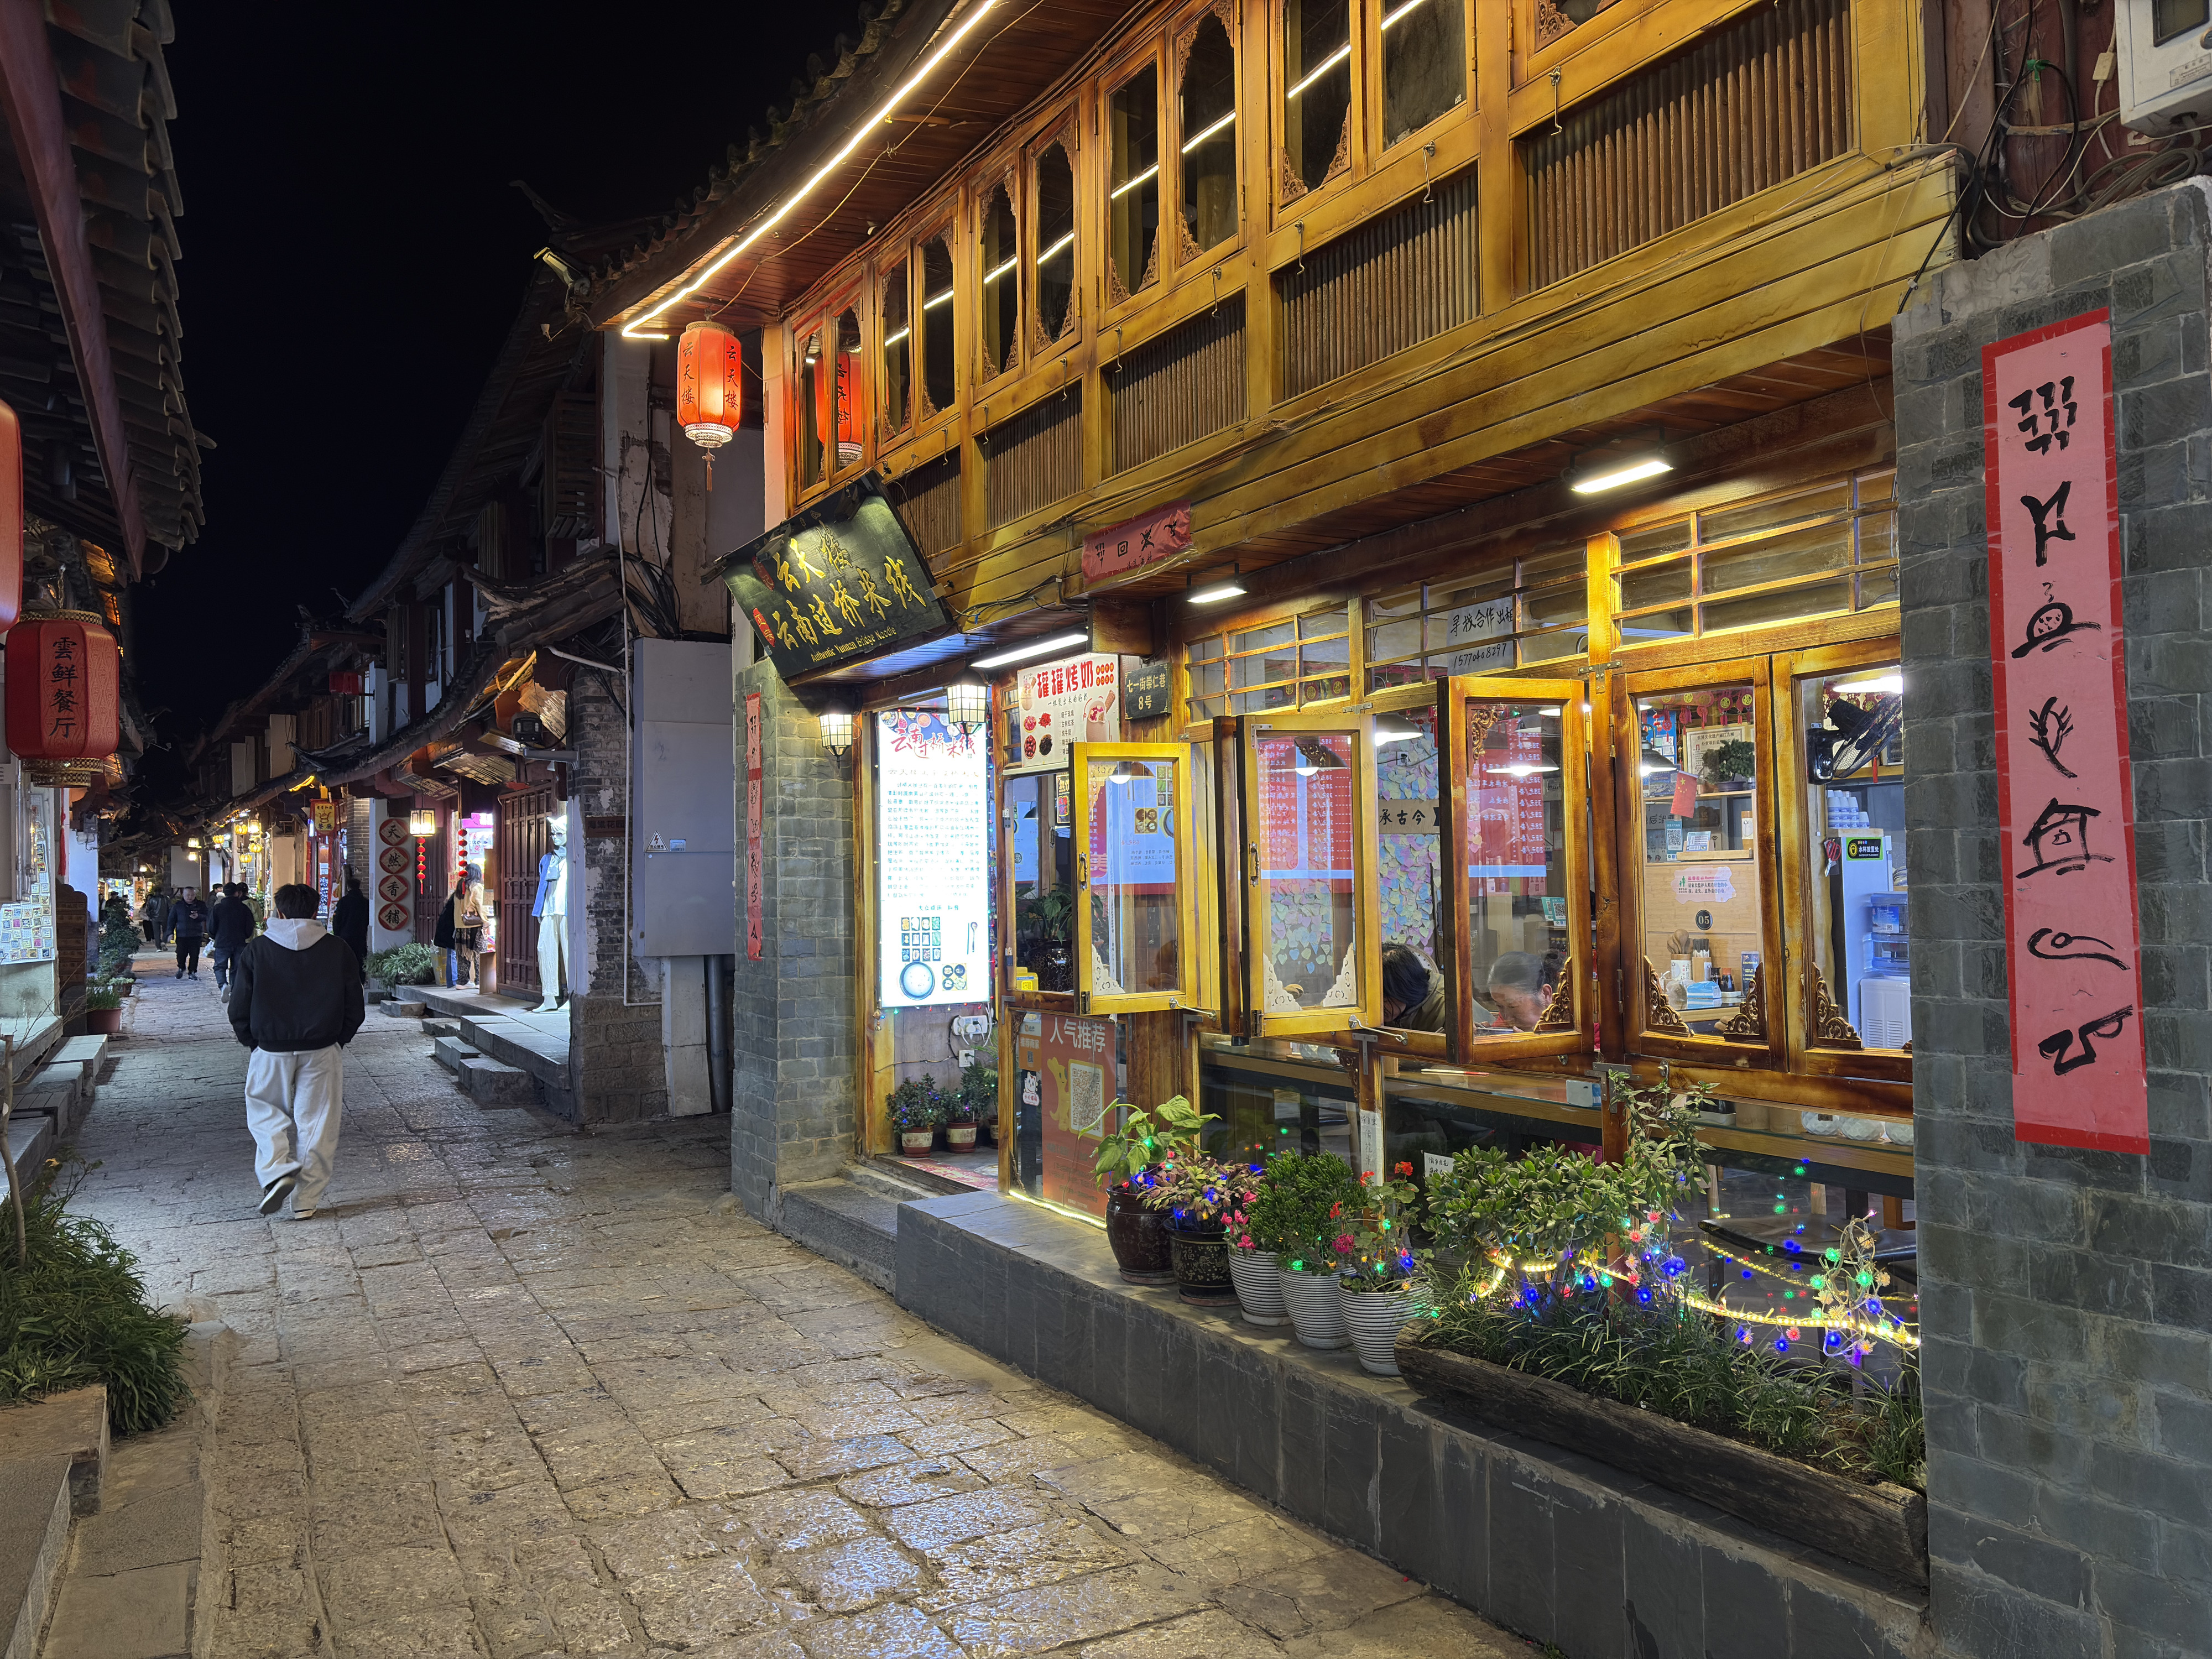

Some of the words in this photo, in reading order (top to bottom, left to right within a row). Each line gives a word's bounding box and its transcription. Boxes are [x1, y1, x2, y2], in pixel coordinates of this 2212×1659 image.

[681, 341, 695, 405] 云天楼
[724, 346, 739, 410] 云天楼
[772, 556, 927, 650] 云南过桥米线
[1450, 607, 1495, 637] 寻找合作
[810, 647, 836, 662] Authentic
[833, 641, 857, 654] Yunnan
[855, 634, 876, 648] Bridge
[874, 625, 897, 640] Noodle
[1454, 643, 1507, 669] 15770408297
[49, 637, 79, 739] 雲鲜餐厅
[1037, 660, 1093, 699] 罐罐烤奶
[1126, 672, 1166, 693] 七一街崇仁巷
[1138, 695, 1152, 711] 8号
[1698, 915, 1710, 925] 05
[1050, 1016, 1106, 1053] 人气推荐
